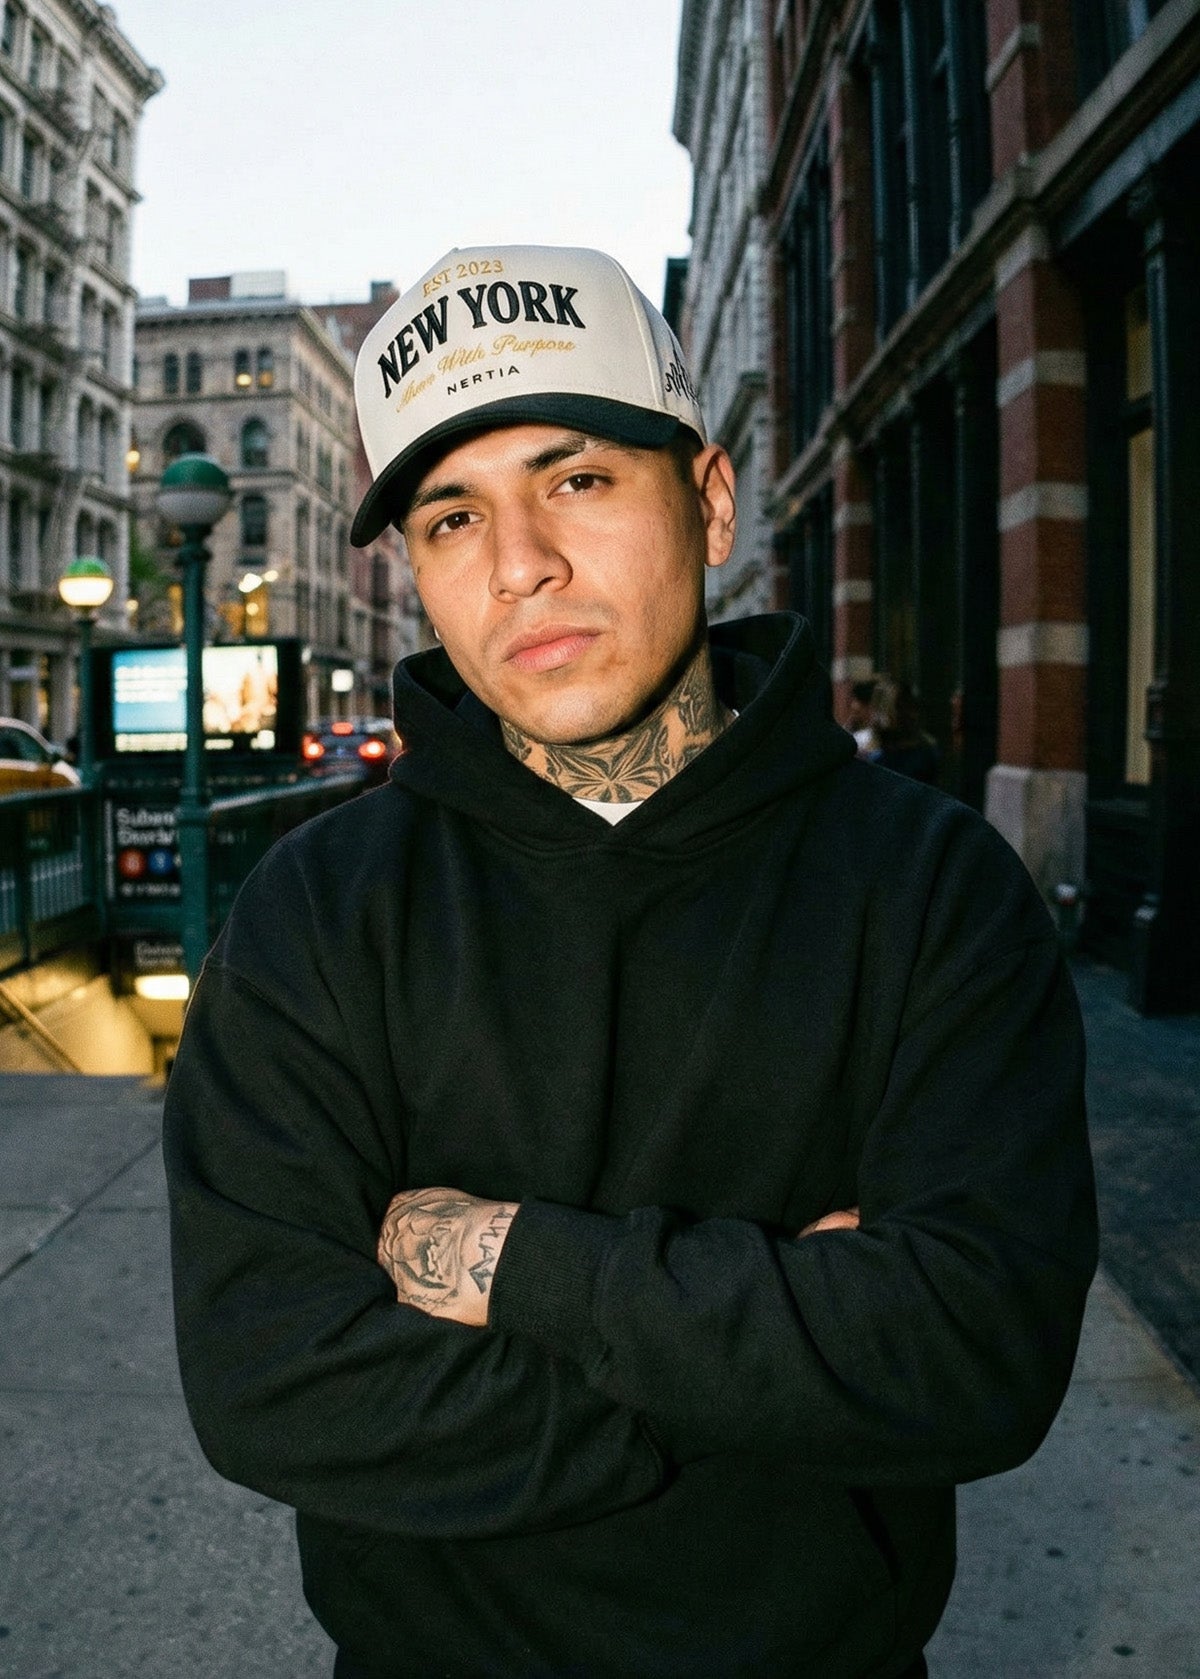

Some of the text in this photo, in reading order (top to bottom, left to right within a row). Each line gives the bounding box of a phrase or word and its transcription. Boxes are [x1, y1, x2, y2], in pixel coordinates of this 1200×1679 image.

[423, 260, 504, 298] EST 2023
[377, 280, 587, 399] NEW YORK
[437, 343, 486, 374] With
[492, 334, 576, 358] Purpose
[447, 365, 521, 395] NERTIA
